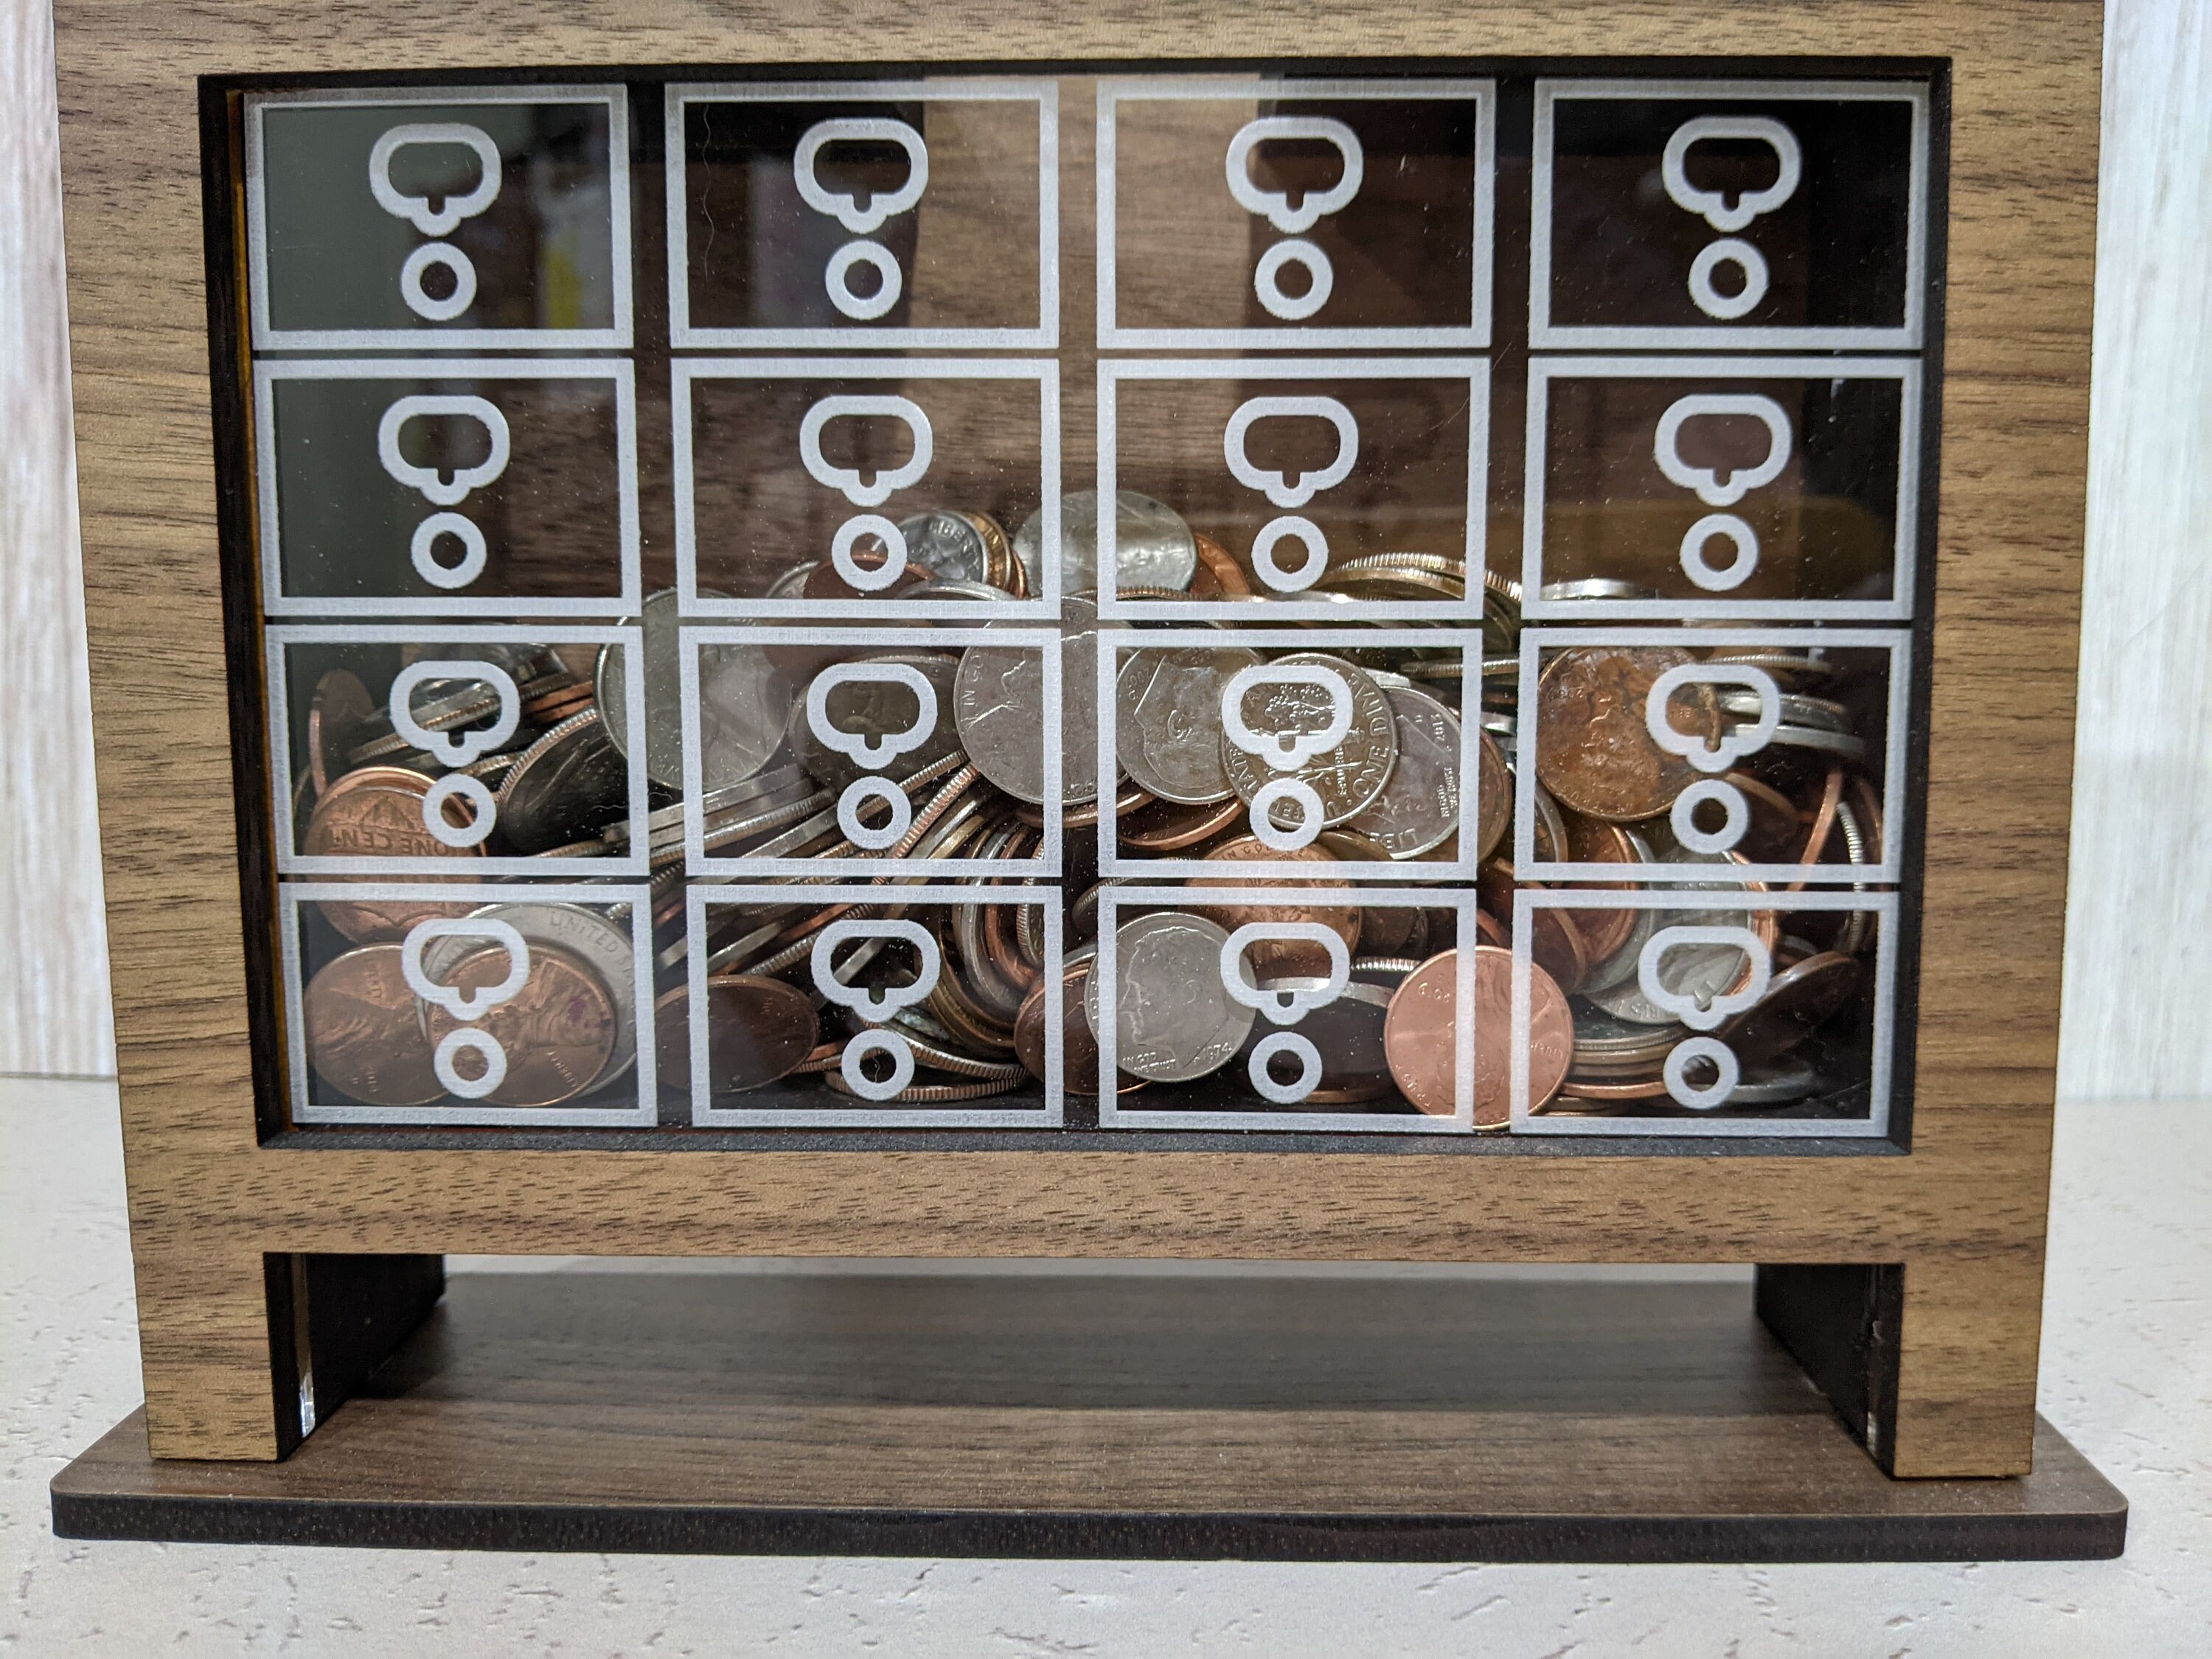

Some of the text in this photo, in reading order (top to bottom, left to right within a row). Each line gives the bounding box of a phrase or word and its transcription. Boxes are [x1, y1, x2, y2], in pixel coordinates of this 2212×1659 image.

[960, 654, 984, 706] IN GO
[1352, 745, 1391, 799] ONE
[332, 828, 449, 856] ONE CENT
[1368, 828, 1419, 850] LIBE
[1221, 850, 1237, 861] IN
[549, 911, 621, 953] UNITED
[1418, 981, 1452, 1004] 209
[1136, 1051, 1157, 1065] GOD
[1530, 1039, 1565, 1060] LIBER
